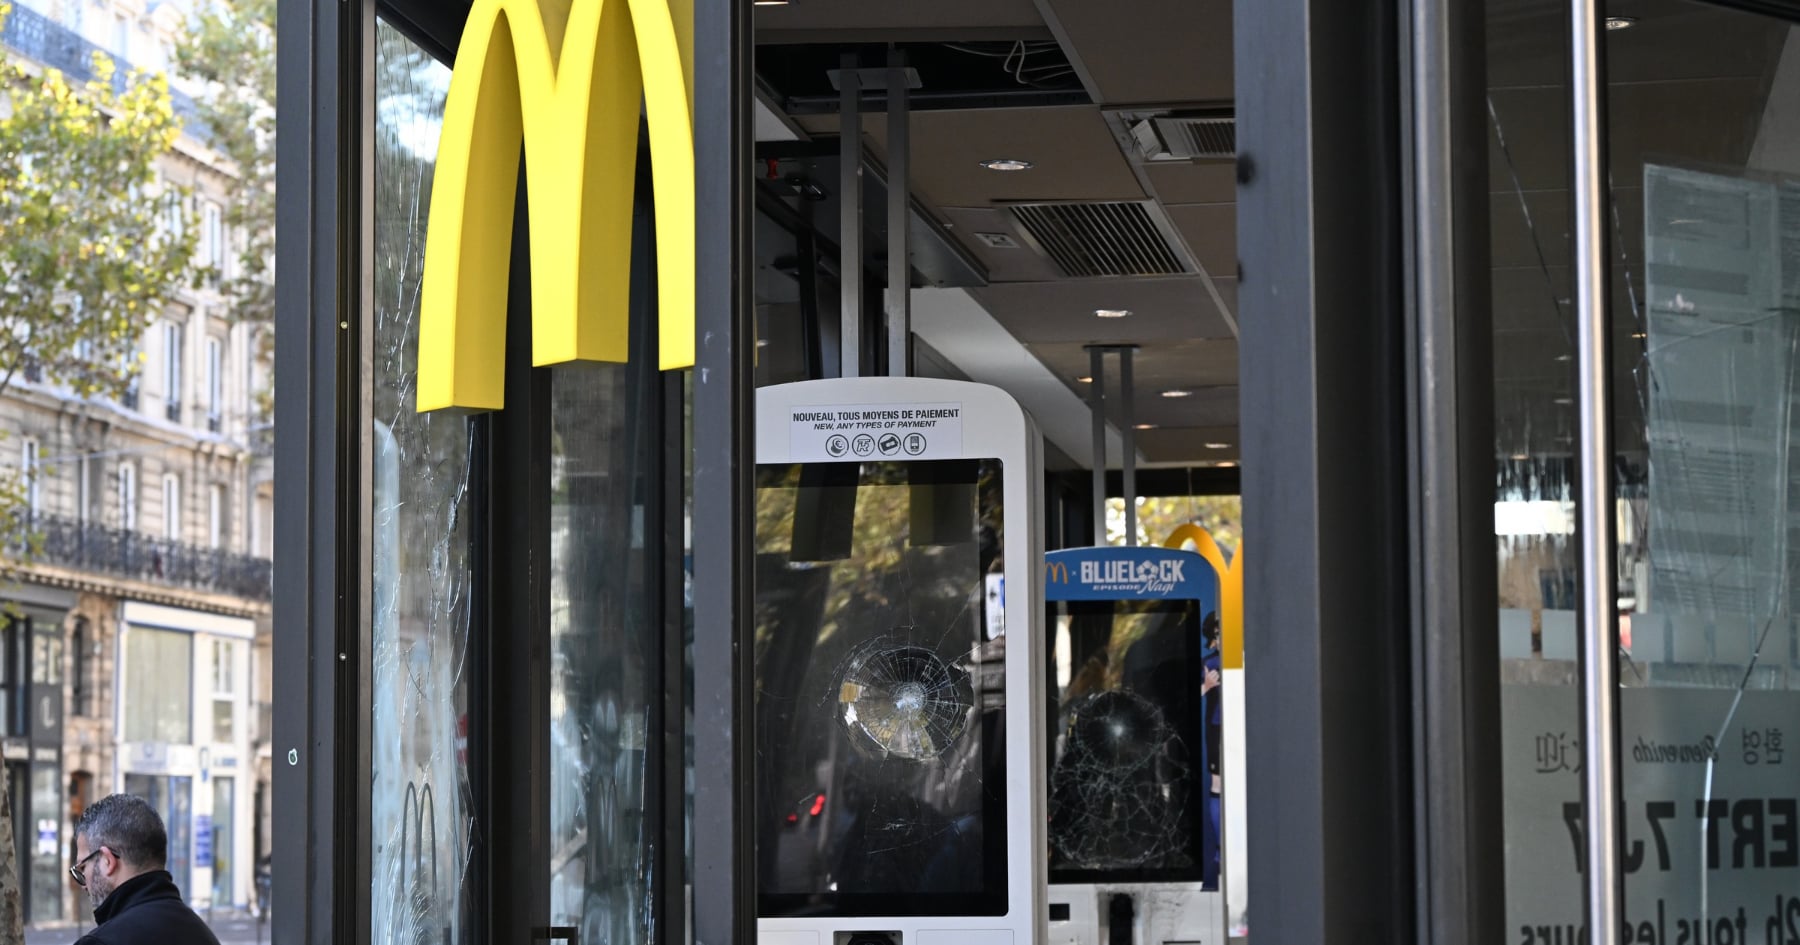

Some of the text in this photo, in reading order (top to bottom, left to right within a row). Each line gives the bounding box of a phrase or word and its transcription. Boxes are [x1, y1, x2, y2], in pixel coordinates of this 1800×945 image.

[793, 409, 960, 422] NOUVEAU, TOUS MOYENS DE PAIEMENT
[813, 420, 937, 431] NEW, ANY TYPES OF PAYMENT
[1137, 579, 1175, 595] Nagi
